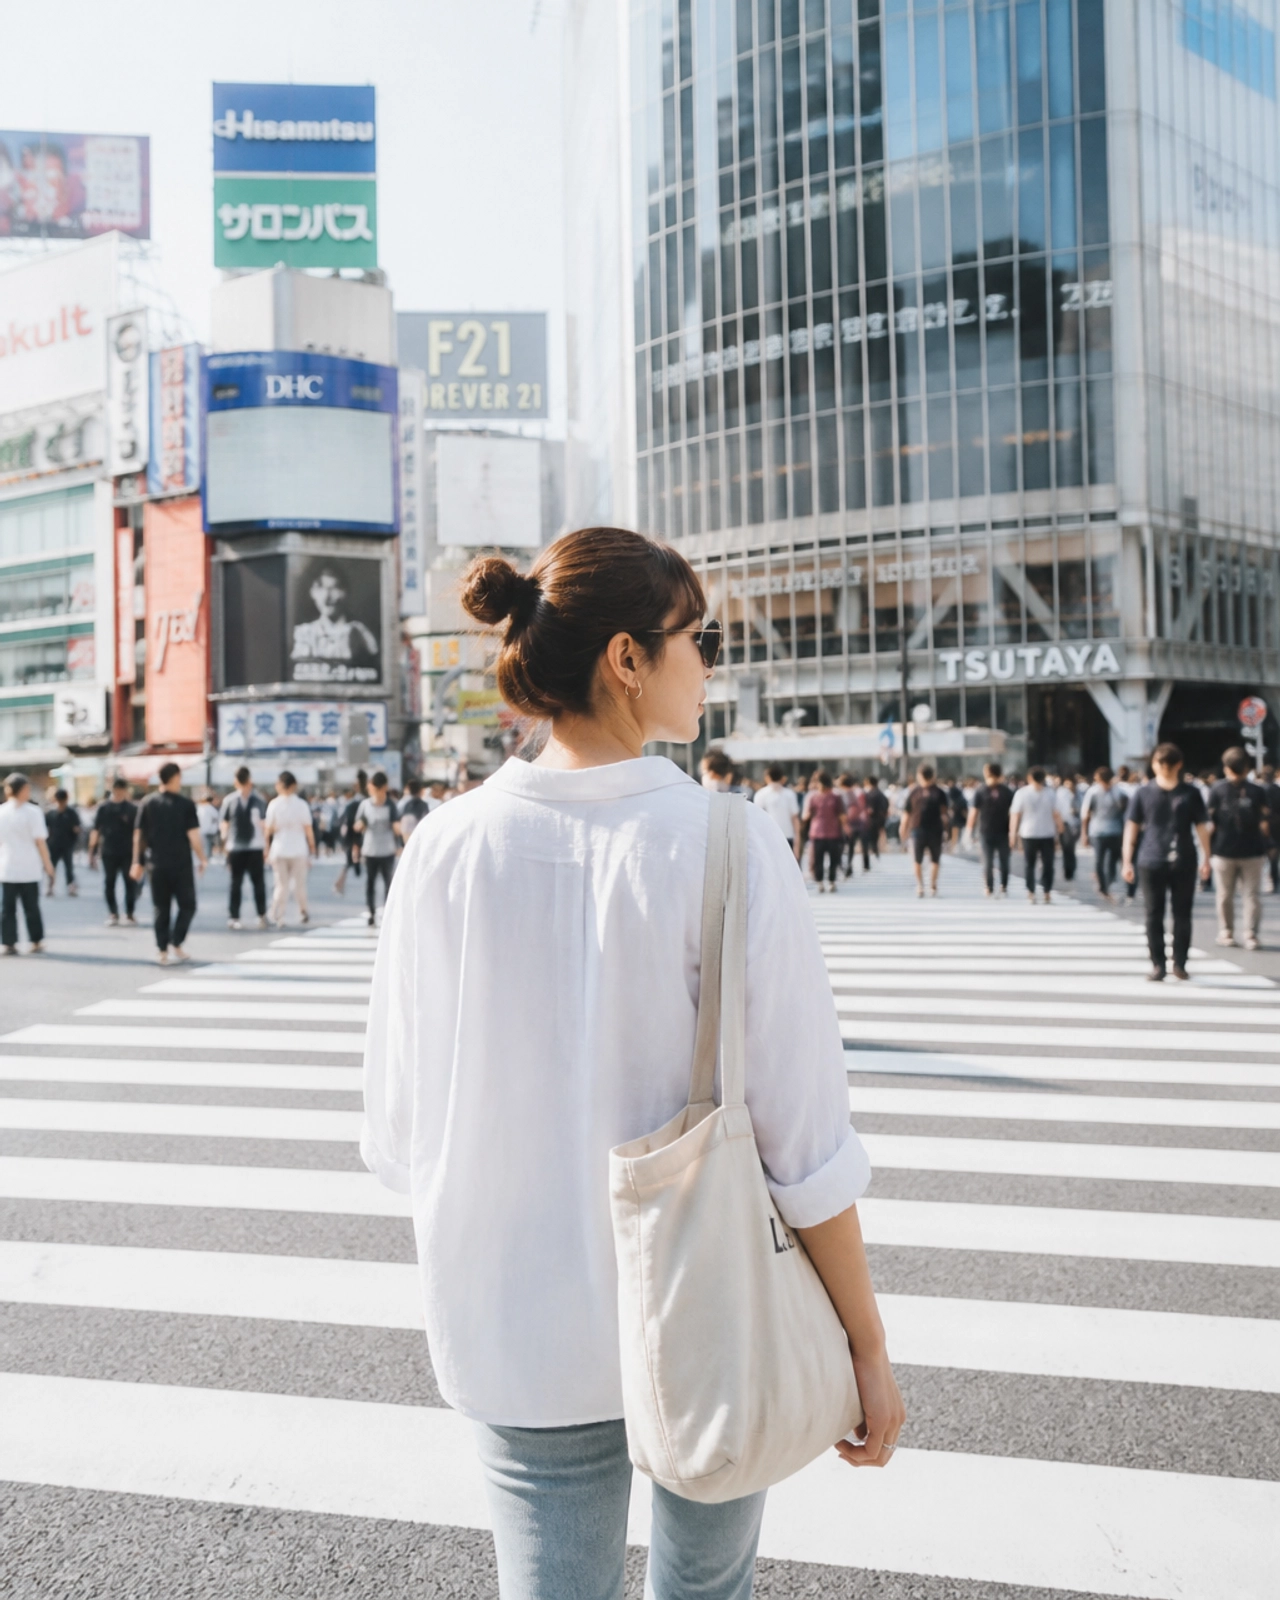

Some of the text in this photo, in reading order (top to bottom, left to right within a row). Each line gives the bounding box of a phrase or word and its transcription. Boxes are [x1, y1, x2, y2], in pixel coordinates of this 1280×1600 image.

[214, 109, 374, 142] Hisamitsu
[217, 203, 374, 241] サロンパス
[427, 320, 511, 377] F21
[266, 374, 324, 400] DHC
[516, 383, 542, 410] 21
[939, 644, 1121, 682] TSUTAYA
